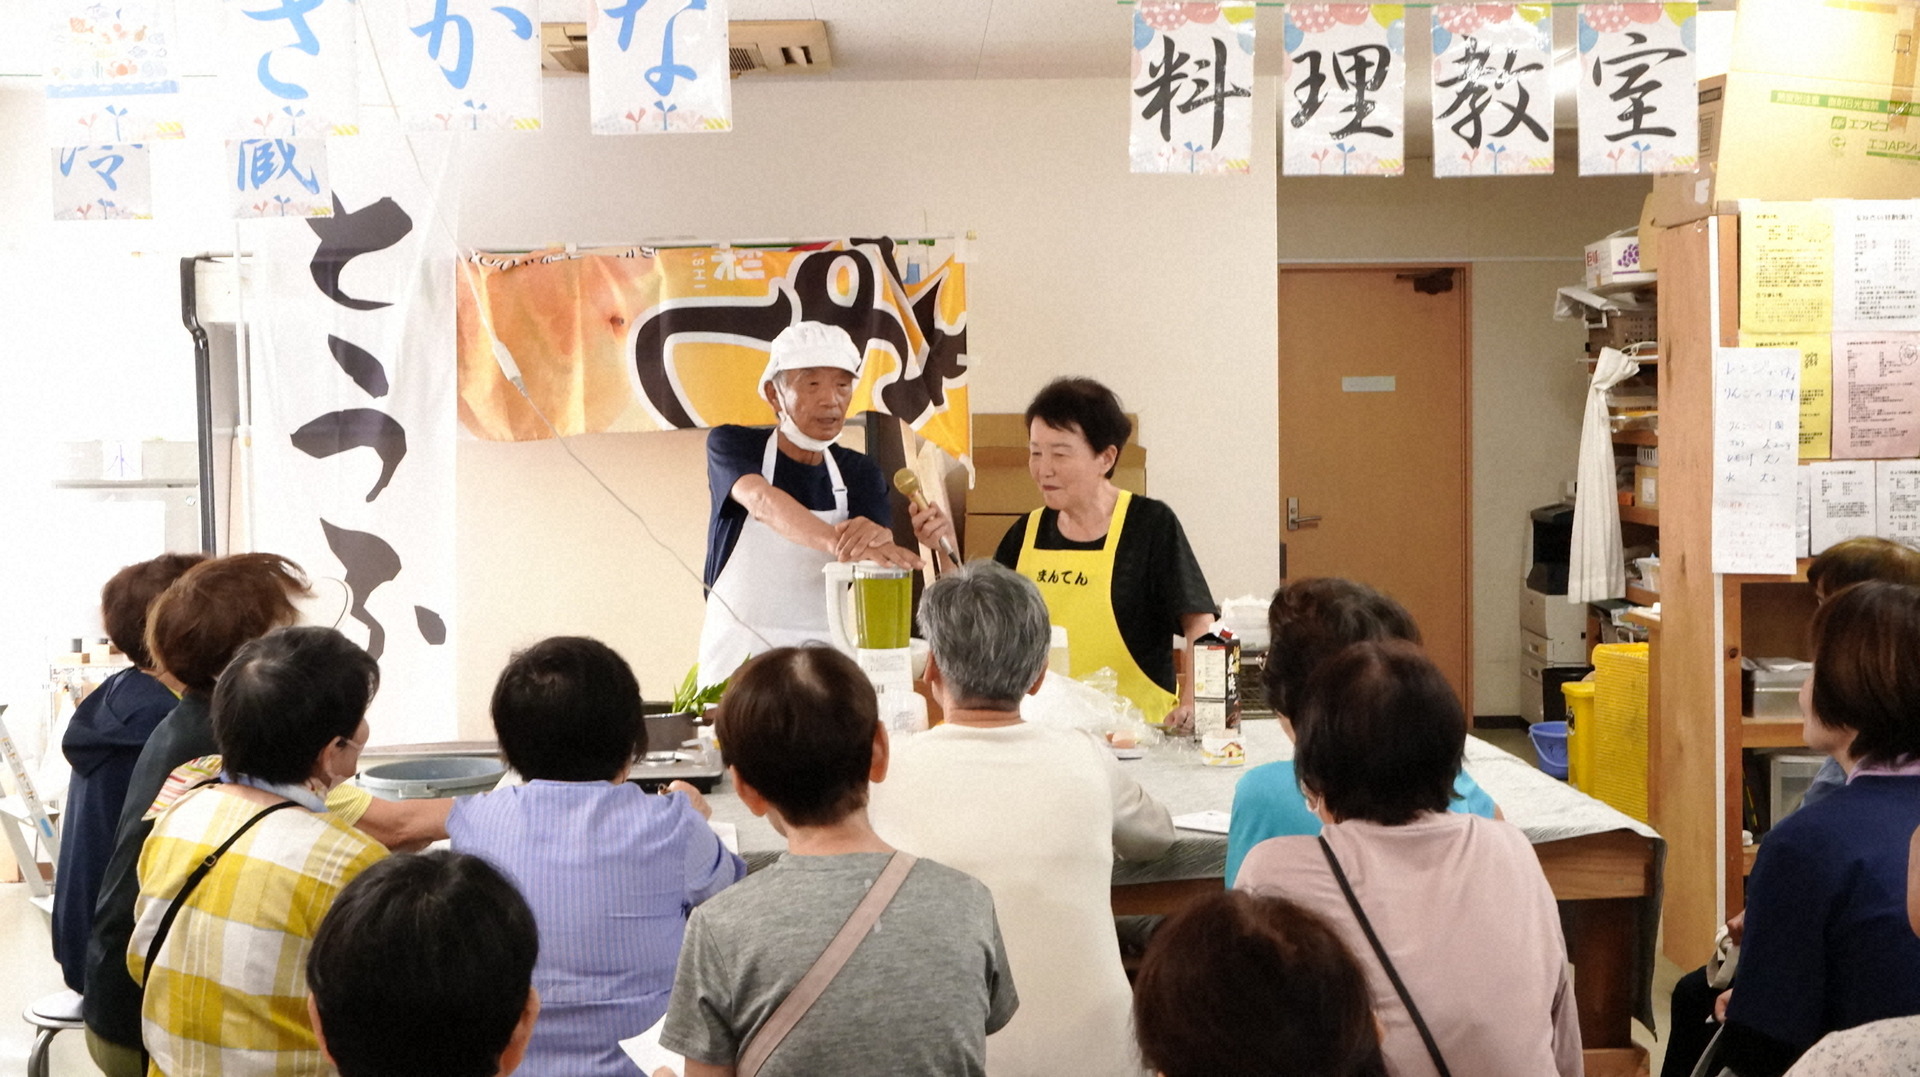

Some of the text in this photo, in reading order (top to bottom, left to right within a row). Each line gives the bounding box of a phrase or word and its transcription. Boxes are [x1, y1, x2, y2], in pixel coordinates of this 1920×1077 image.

[1133, 32, 1687, 151] 料理教室
[1036, 569, 1089, 587] まんてん
